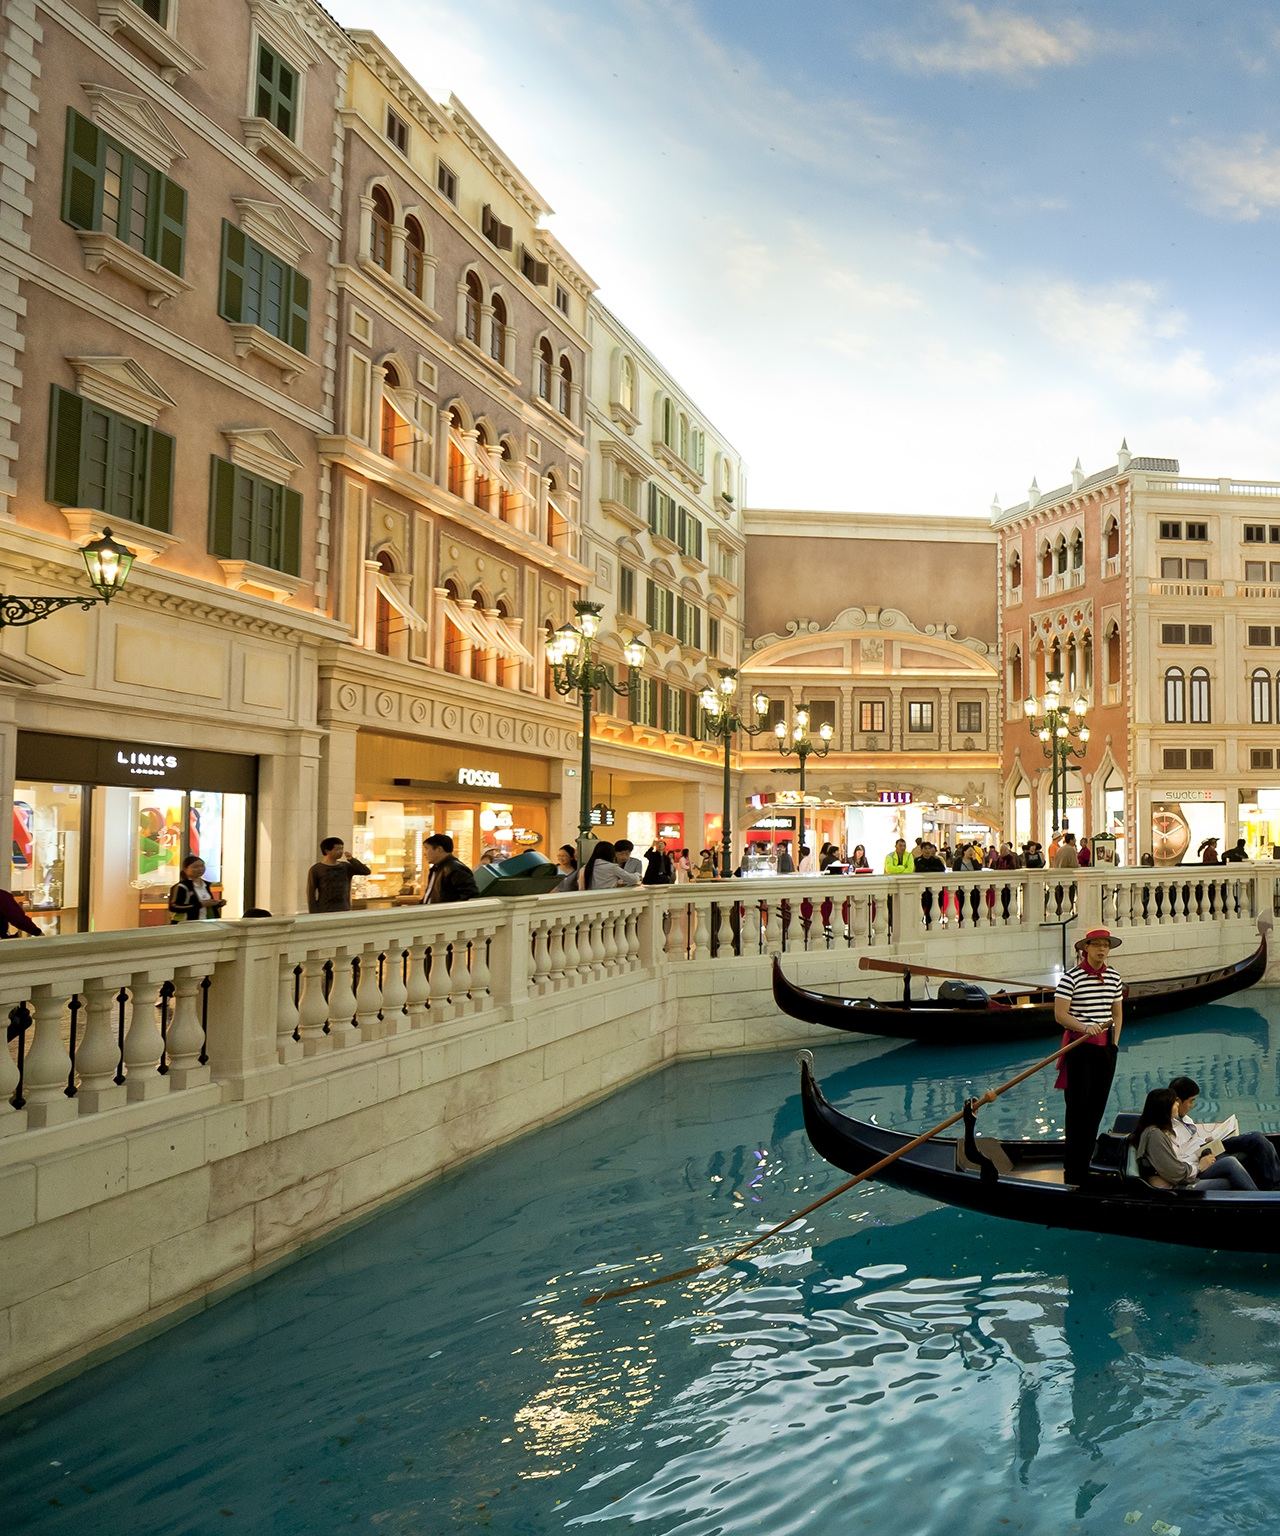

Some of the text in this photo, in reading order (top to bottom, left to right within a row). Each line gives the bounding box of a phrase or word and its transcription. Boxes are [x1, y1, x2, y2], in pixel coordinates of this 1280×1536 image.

[117, 751, 178, 768] LINKS
[458, 767, 502, 788] FOSSIL
[1165, 790, 1204, 800] swatch
[164, 834, 177, 847] 21
